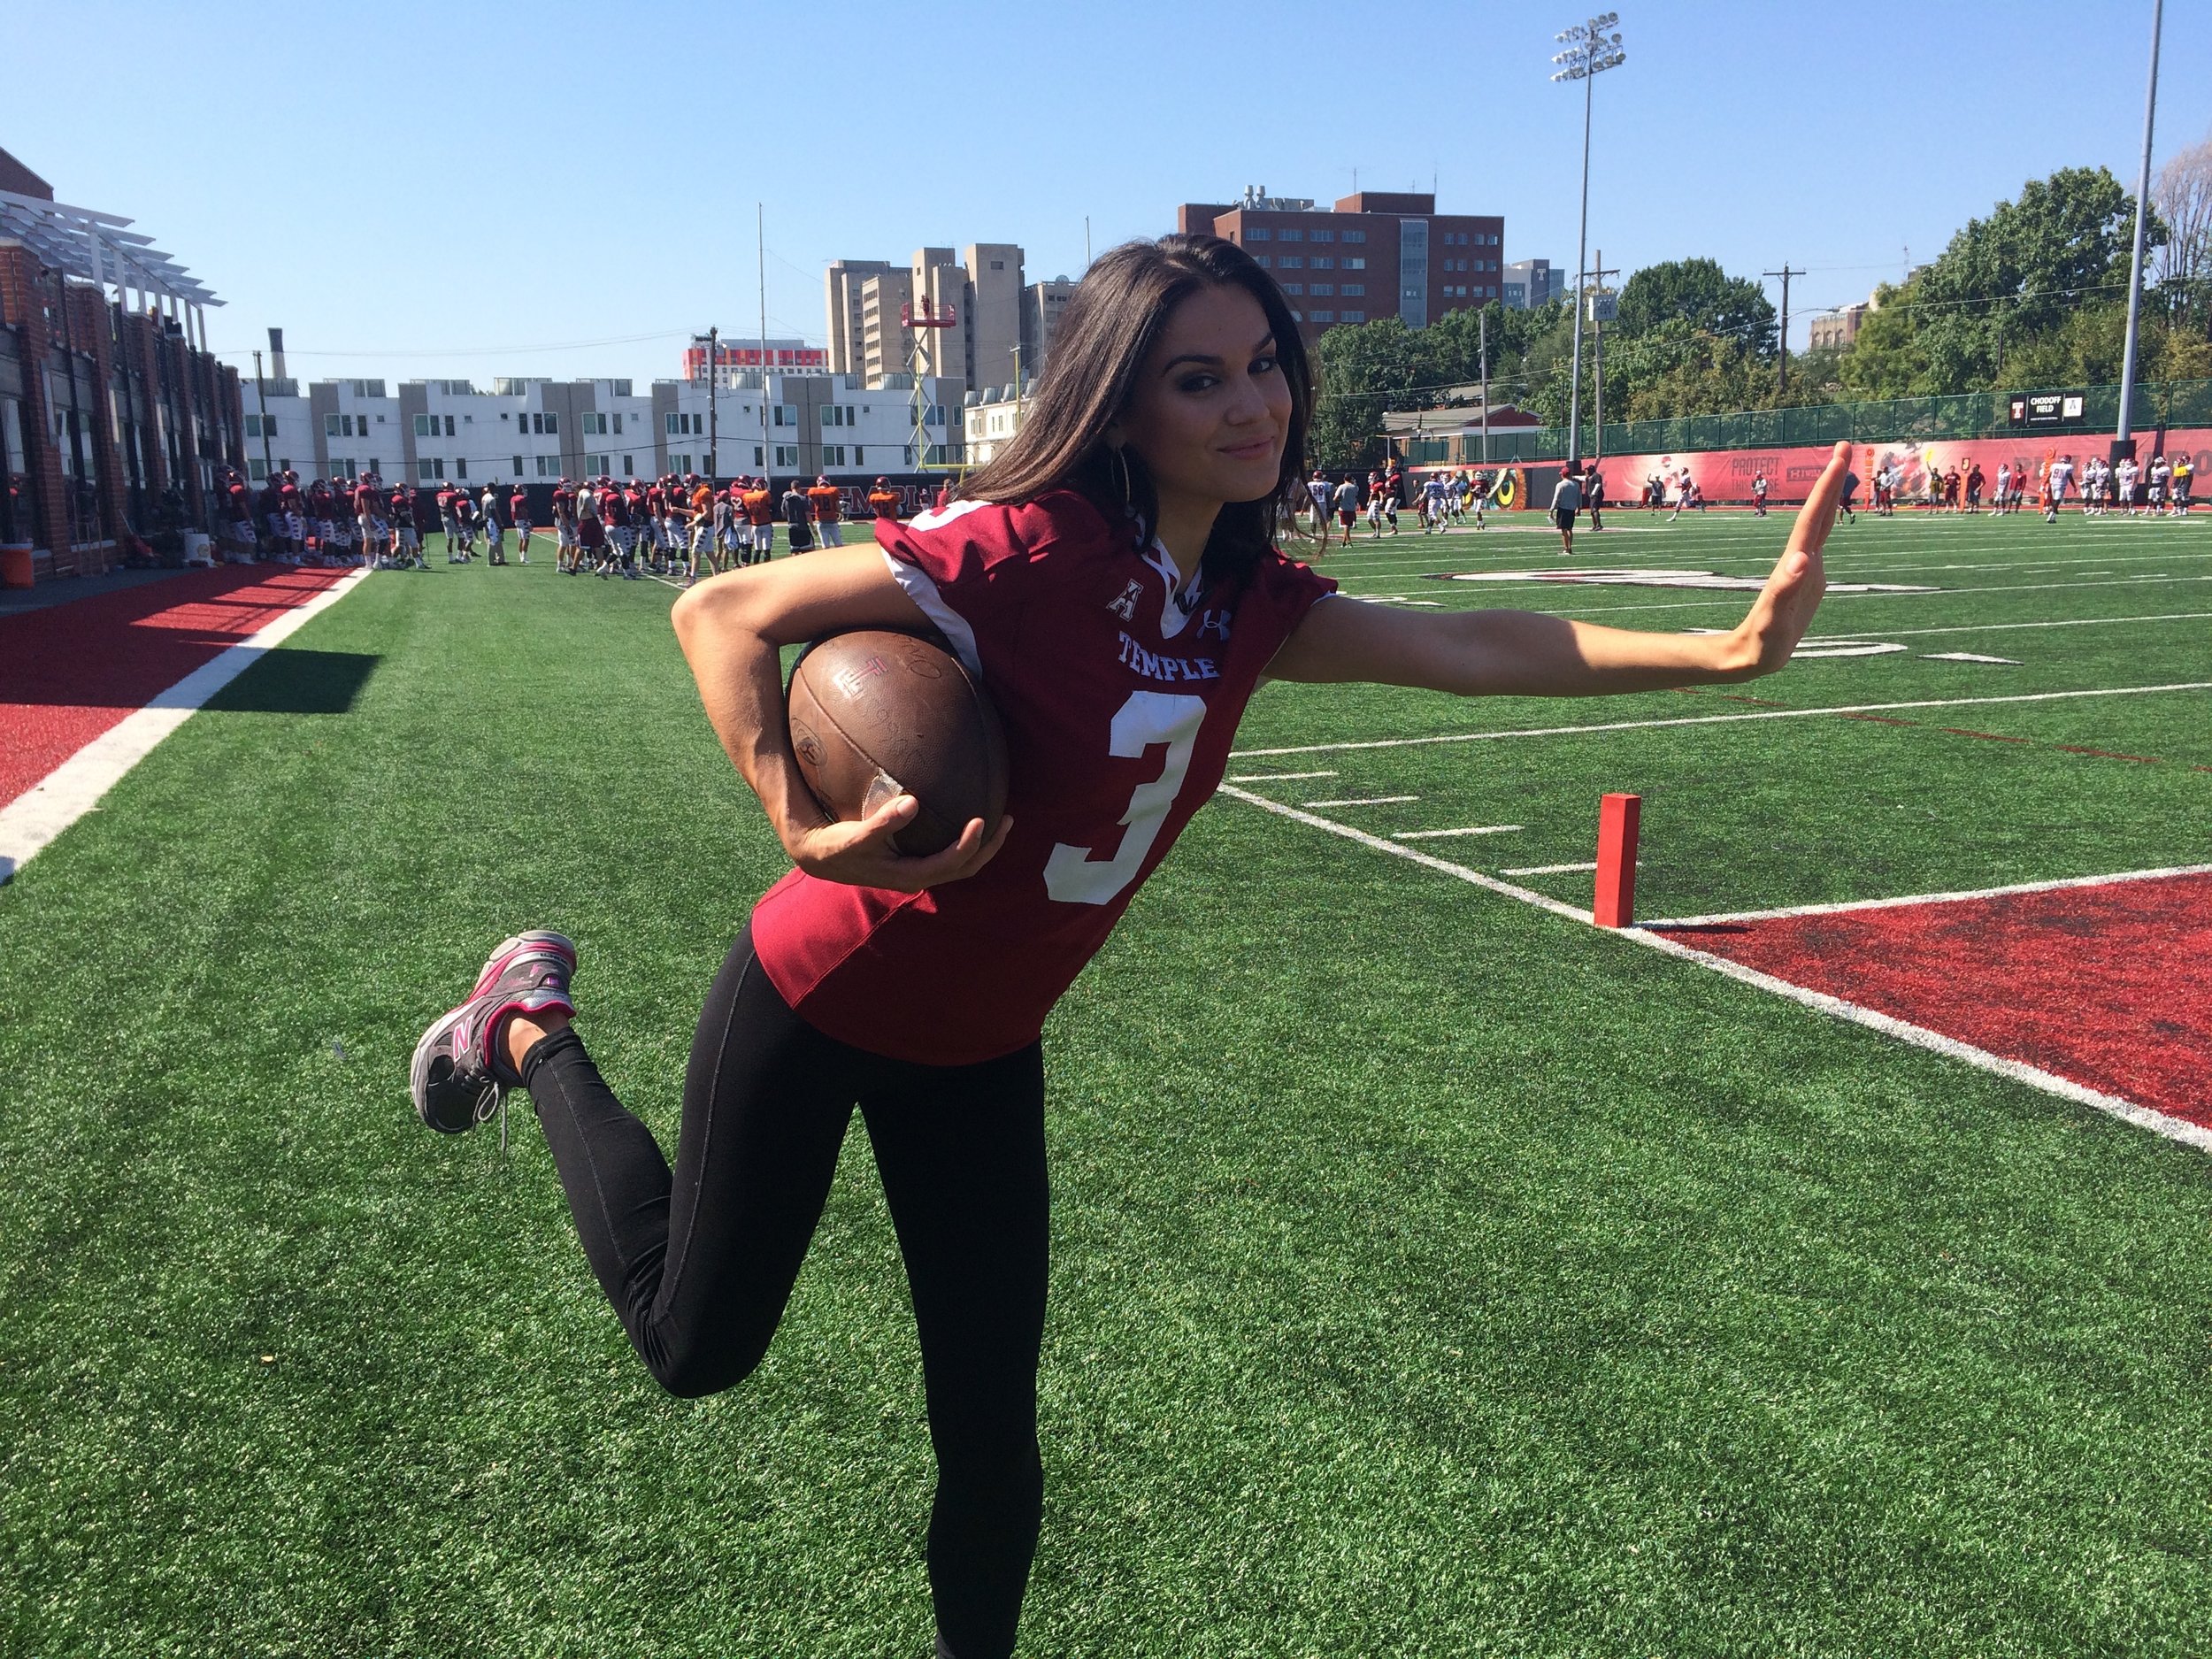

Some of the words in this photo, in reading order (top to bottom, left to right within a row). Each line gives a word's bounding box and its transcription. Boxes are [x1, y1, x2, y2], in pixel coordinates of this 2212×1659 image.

[2030, 396, 2062, 405] CHODOFF
[2036, 404, 2055, 413] FIELD
[1732, 457, 1779, 476] PROTECT
[1118, 630, 1221, 682] TEMPLE
[1042, 690, 1207, 905] 3
[452, 1013, 474, 1063] N
